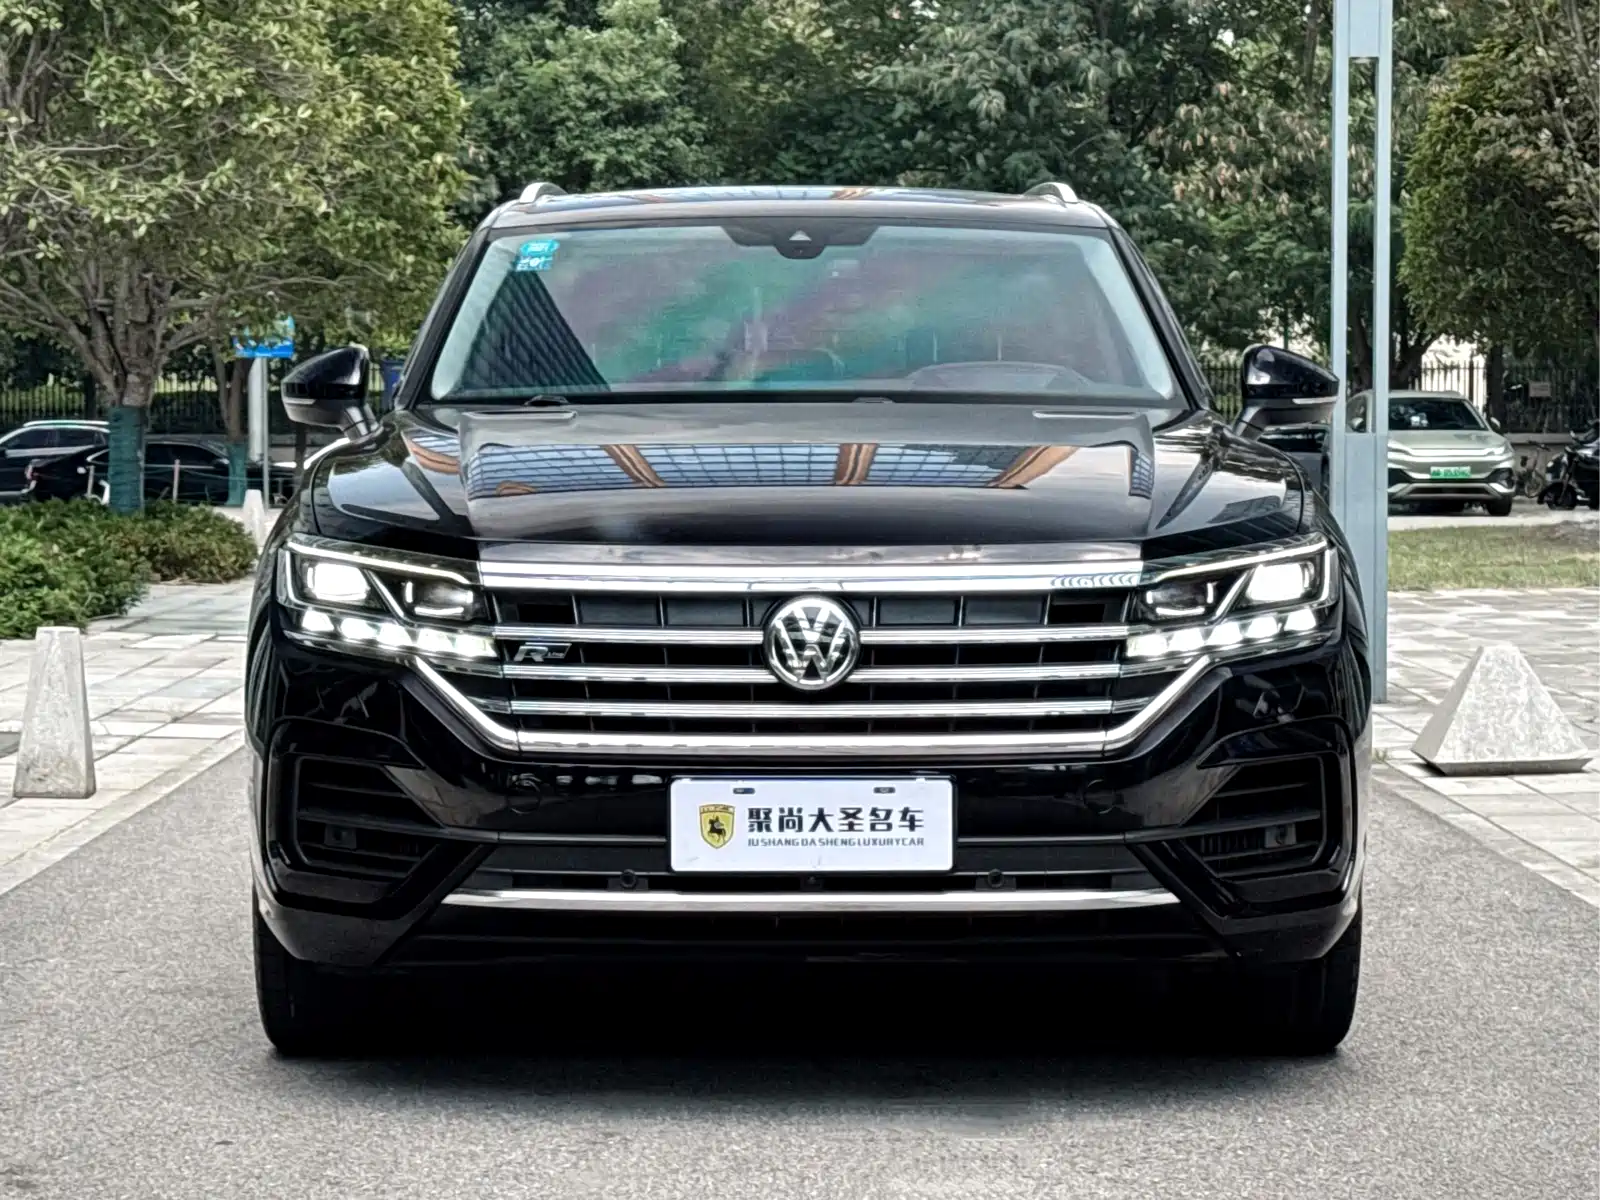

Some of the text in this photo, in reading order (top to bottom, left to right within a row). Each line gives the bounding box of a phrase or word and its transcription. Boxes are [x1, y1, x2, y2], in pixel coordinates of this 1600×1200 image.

[748, 806, 924, 833] 聚尚大圣名车
